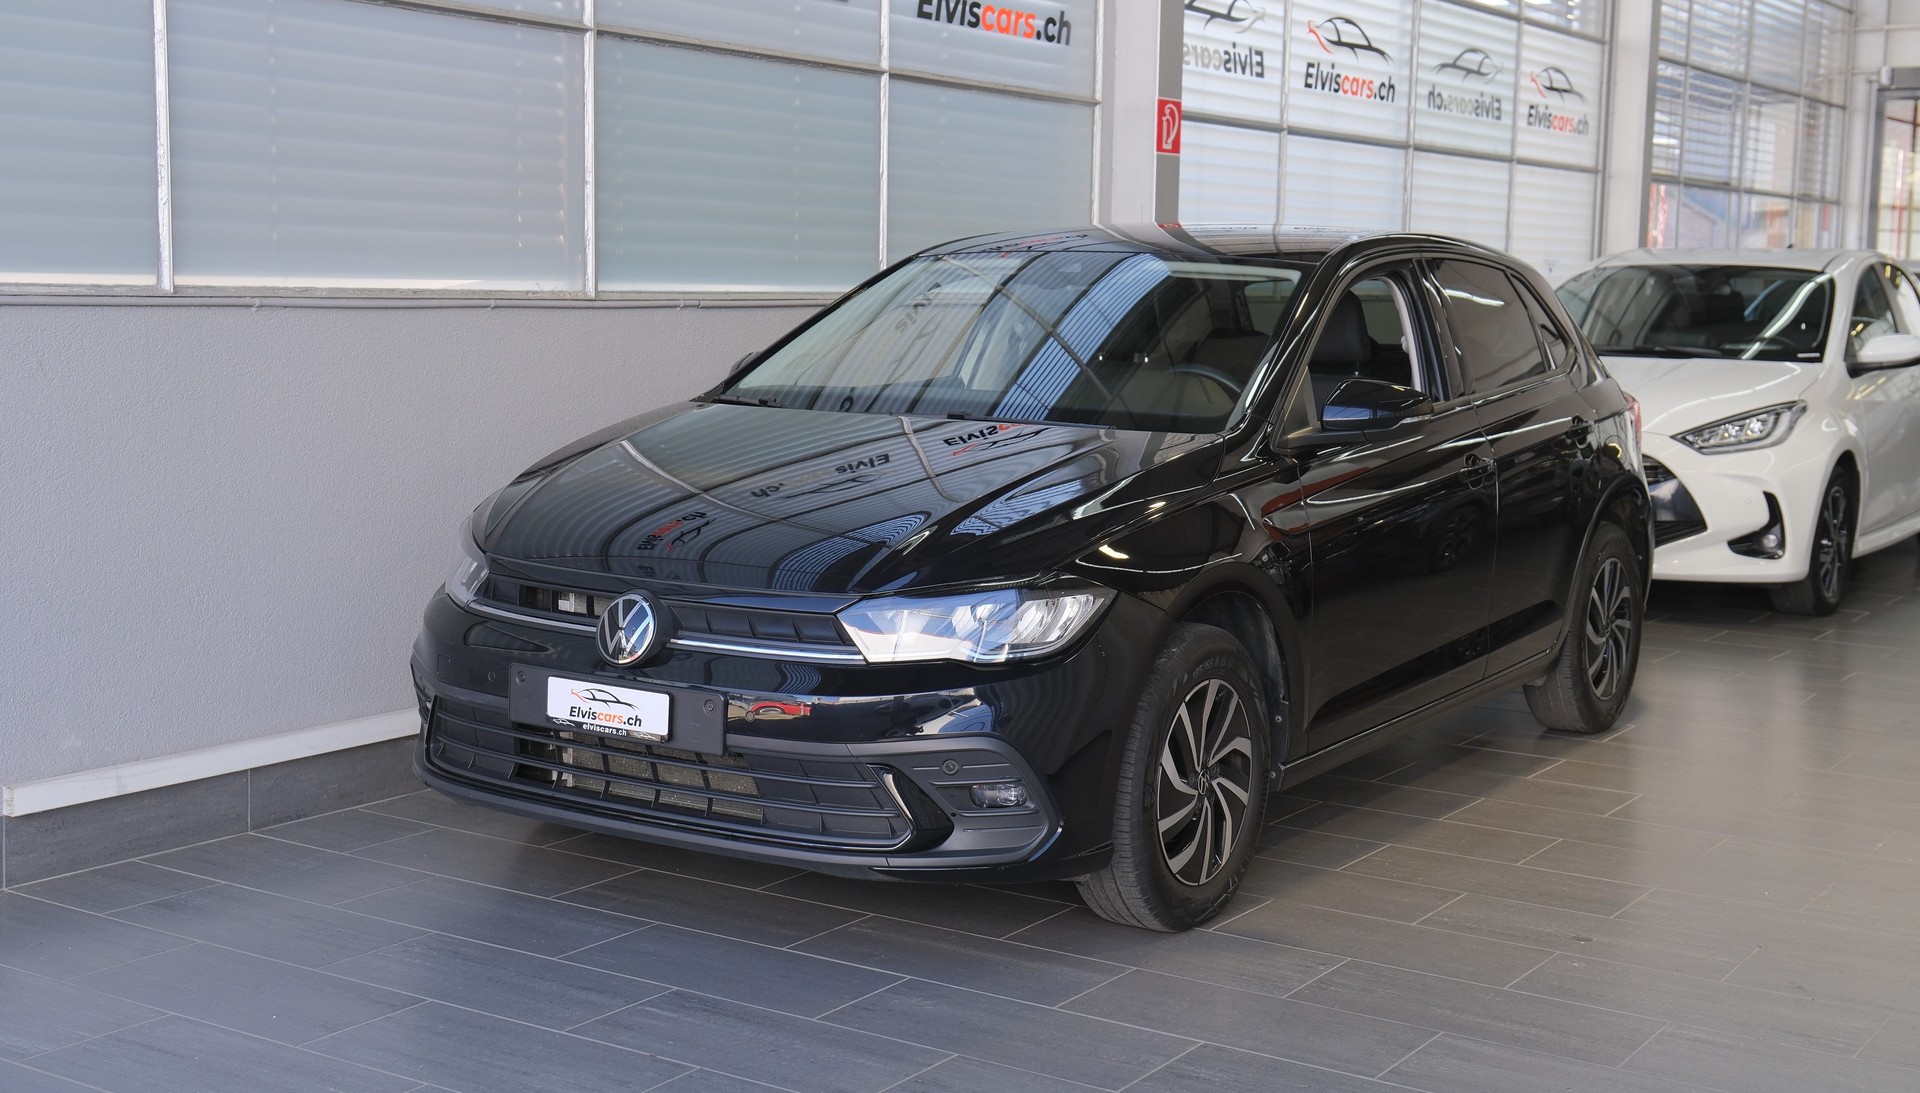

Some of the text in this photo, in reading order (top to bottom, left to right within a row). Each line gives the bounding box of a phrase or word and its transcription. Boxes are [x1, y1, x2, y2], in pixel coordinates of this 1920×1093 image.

[1304, 62, 1395, 103] Elviscars.ch
[1527, 104, 1589, 136] Elviscars.ch
[569, 706, 642, 727] Elviscars.ch
[582, 723, 627, 737] elviscars.ch
